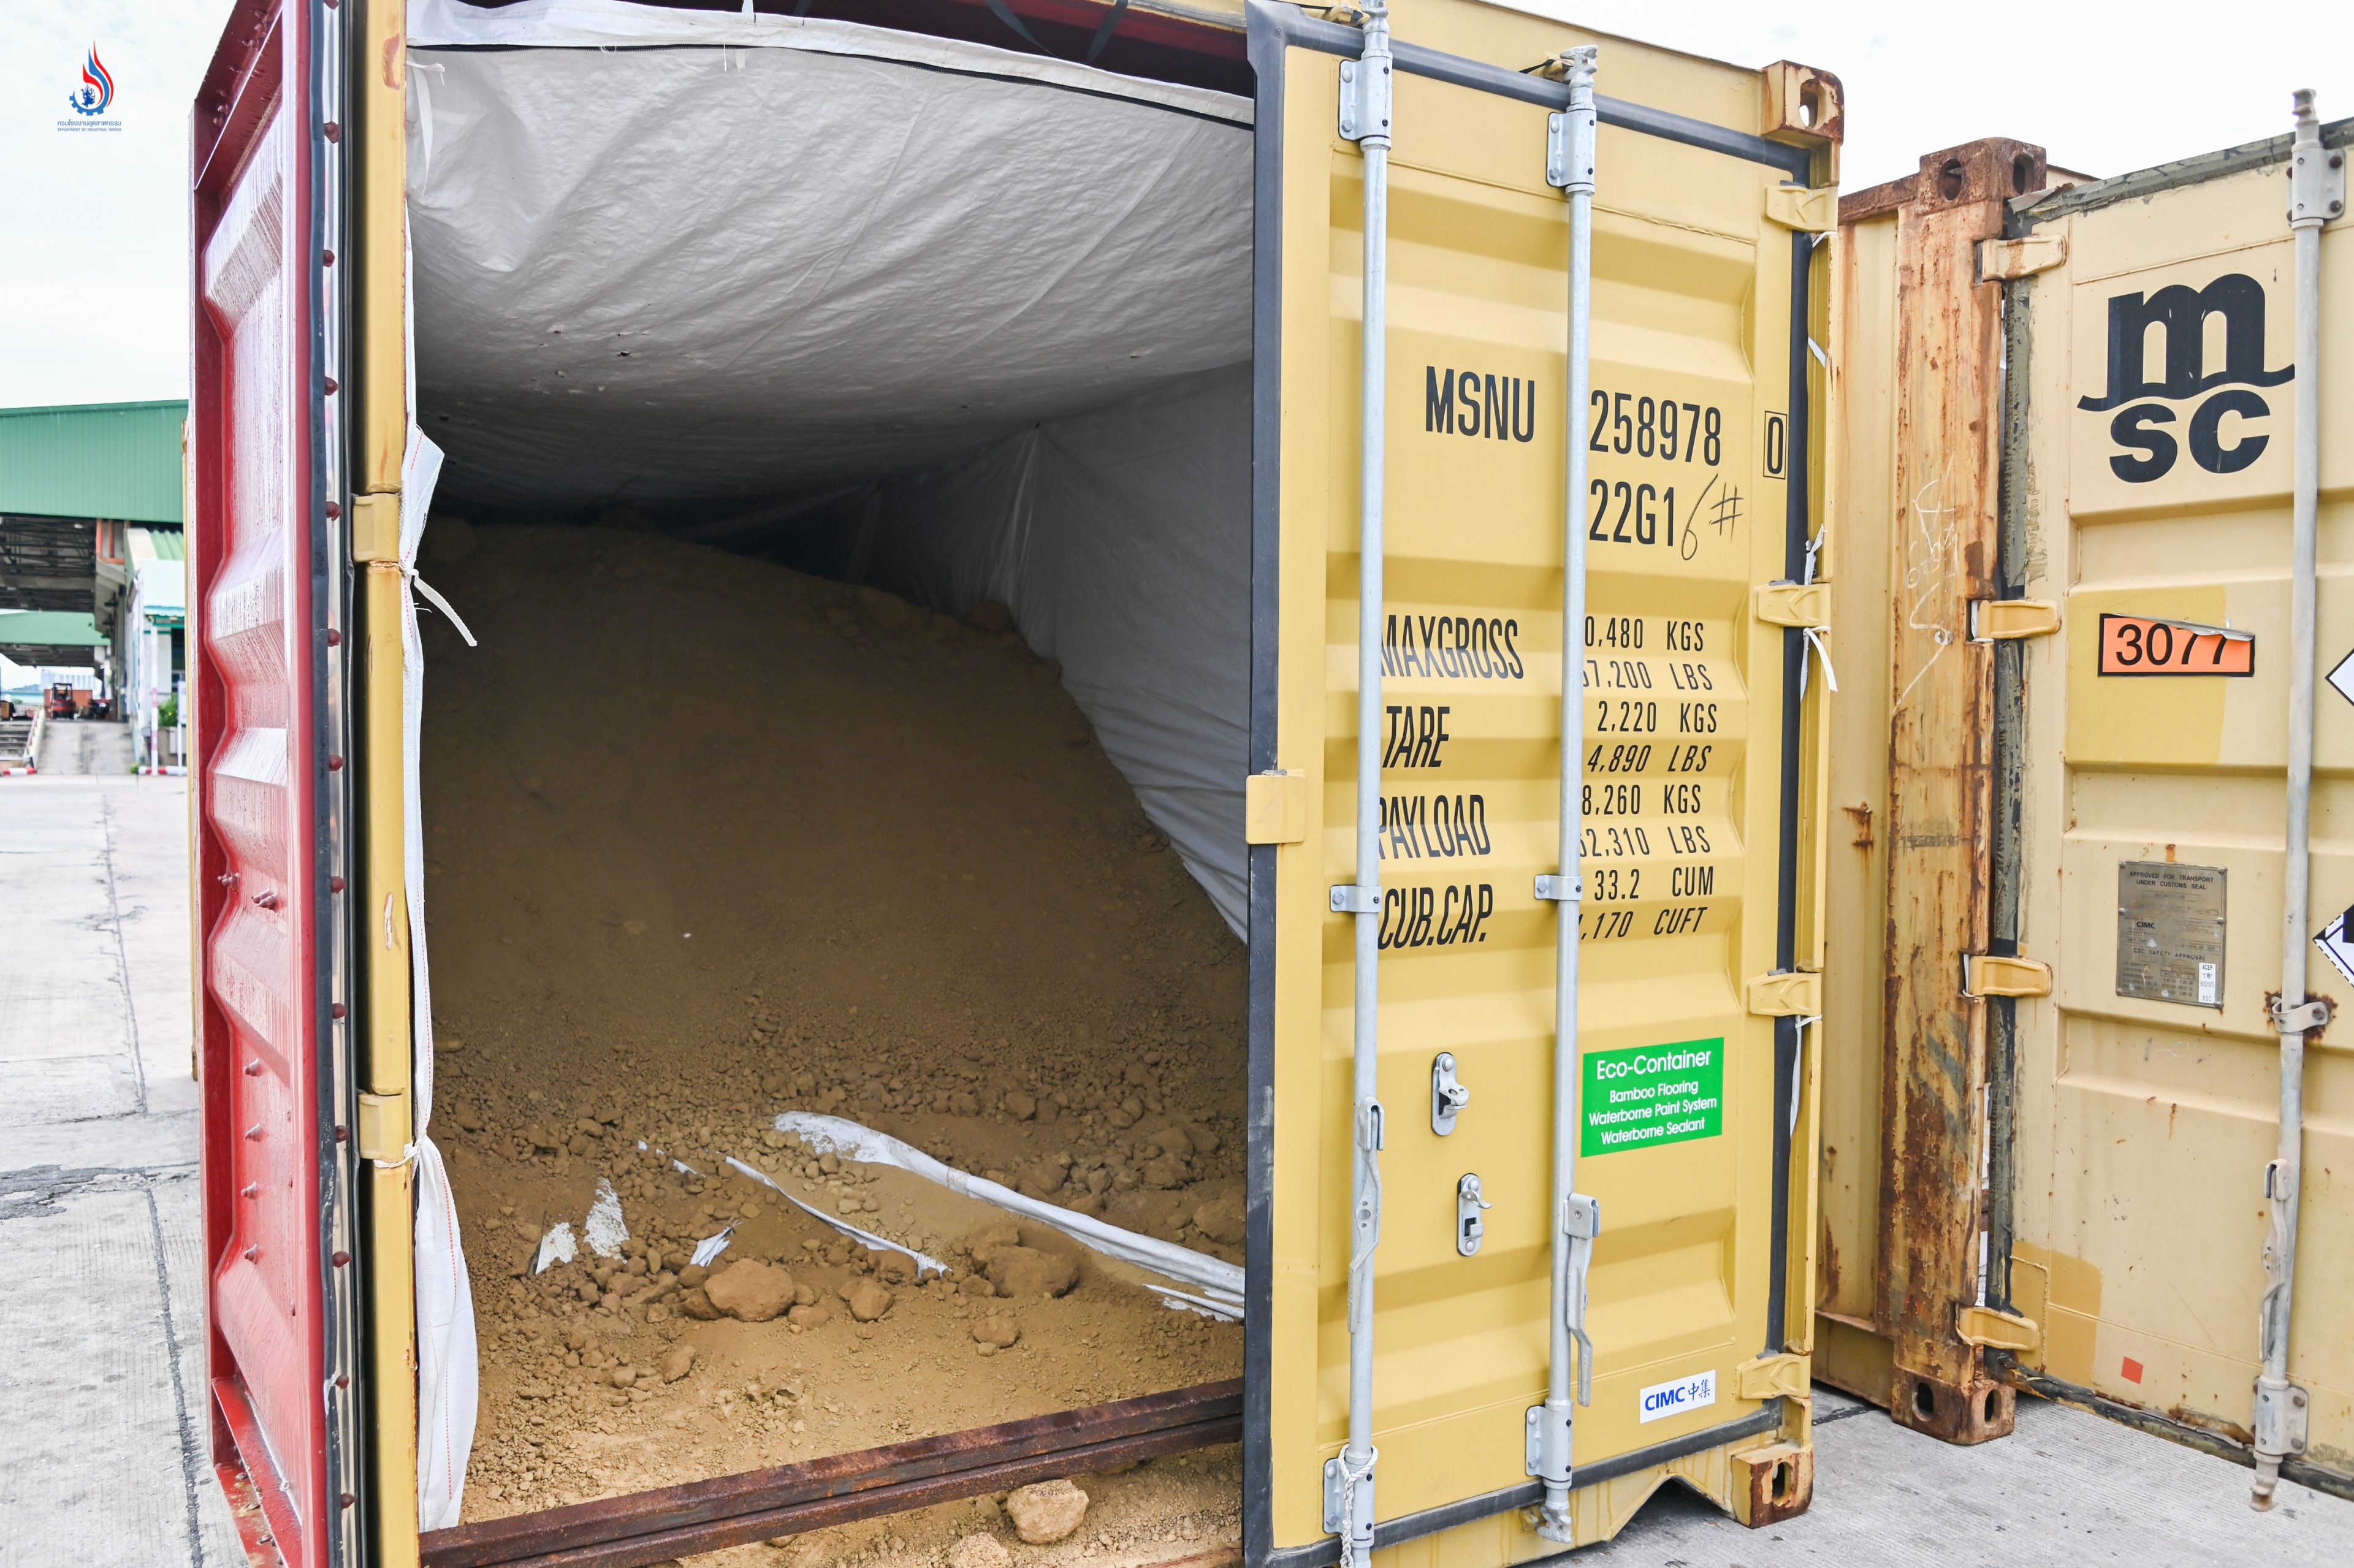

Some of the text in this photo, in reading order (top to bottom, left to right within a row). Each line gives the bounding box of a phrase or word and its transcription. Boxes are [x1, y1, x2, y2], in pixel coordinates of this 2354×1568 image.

[1426, 366, 1534, 442] MSNU
[1590, 390, 1721, 466] 258978
[1590, 479, 1674, 547] 22G1
[1381, 615, 1704, 679] MAXGROSS 0,480 KGS
[1669, 663, 1713, 690] LBS
[1382, 701, 1717, 768] TARE 2,220 KGS
[1587, 745, 1712, 772] 4,890 LBS
[1379, 785, 1701, 859] PAYLOAD 8,260 KGS
[1667, 826, 1710, 854] LBS
[1378, 866, 1714, 950] CUB.CAP. 33.2 CUM
[1653, 907, 1708, 935] CUFT
[1596, 1049, 1712, 1081] Eco-Container
[1609, 1081, 1699, 1103] Bamboo Flooring
[1588, 1097, 1717, 1126] Waterborne Paint System
[1601, 1117, 1705, 1145] Waterborne Sealant
[1645, 1379, 1711, 1411] CIMC 中集
